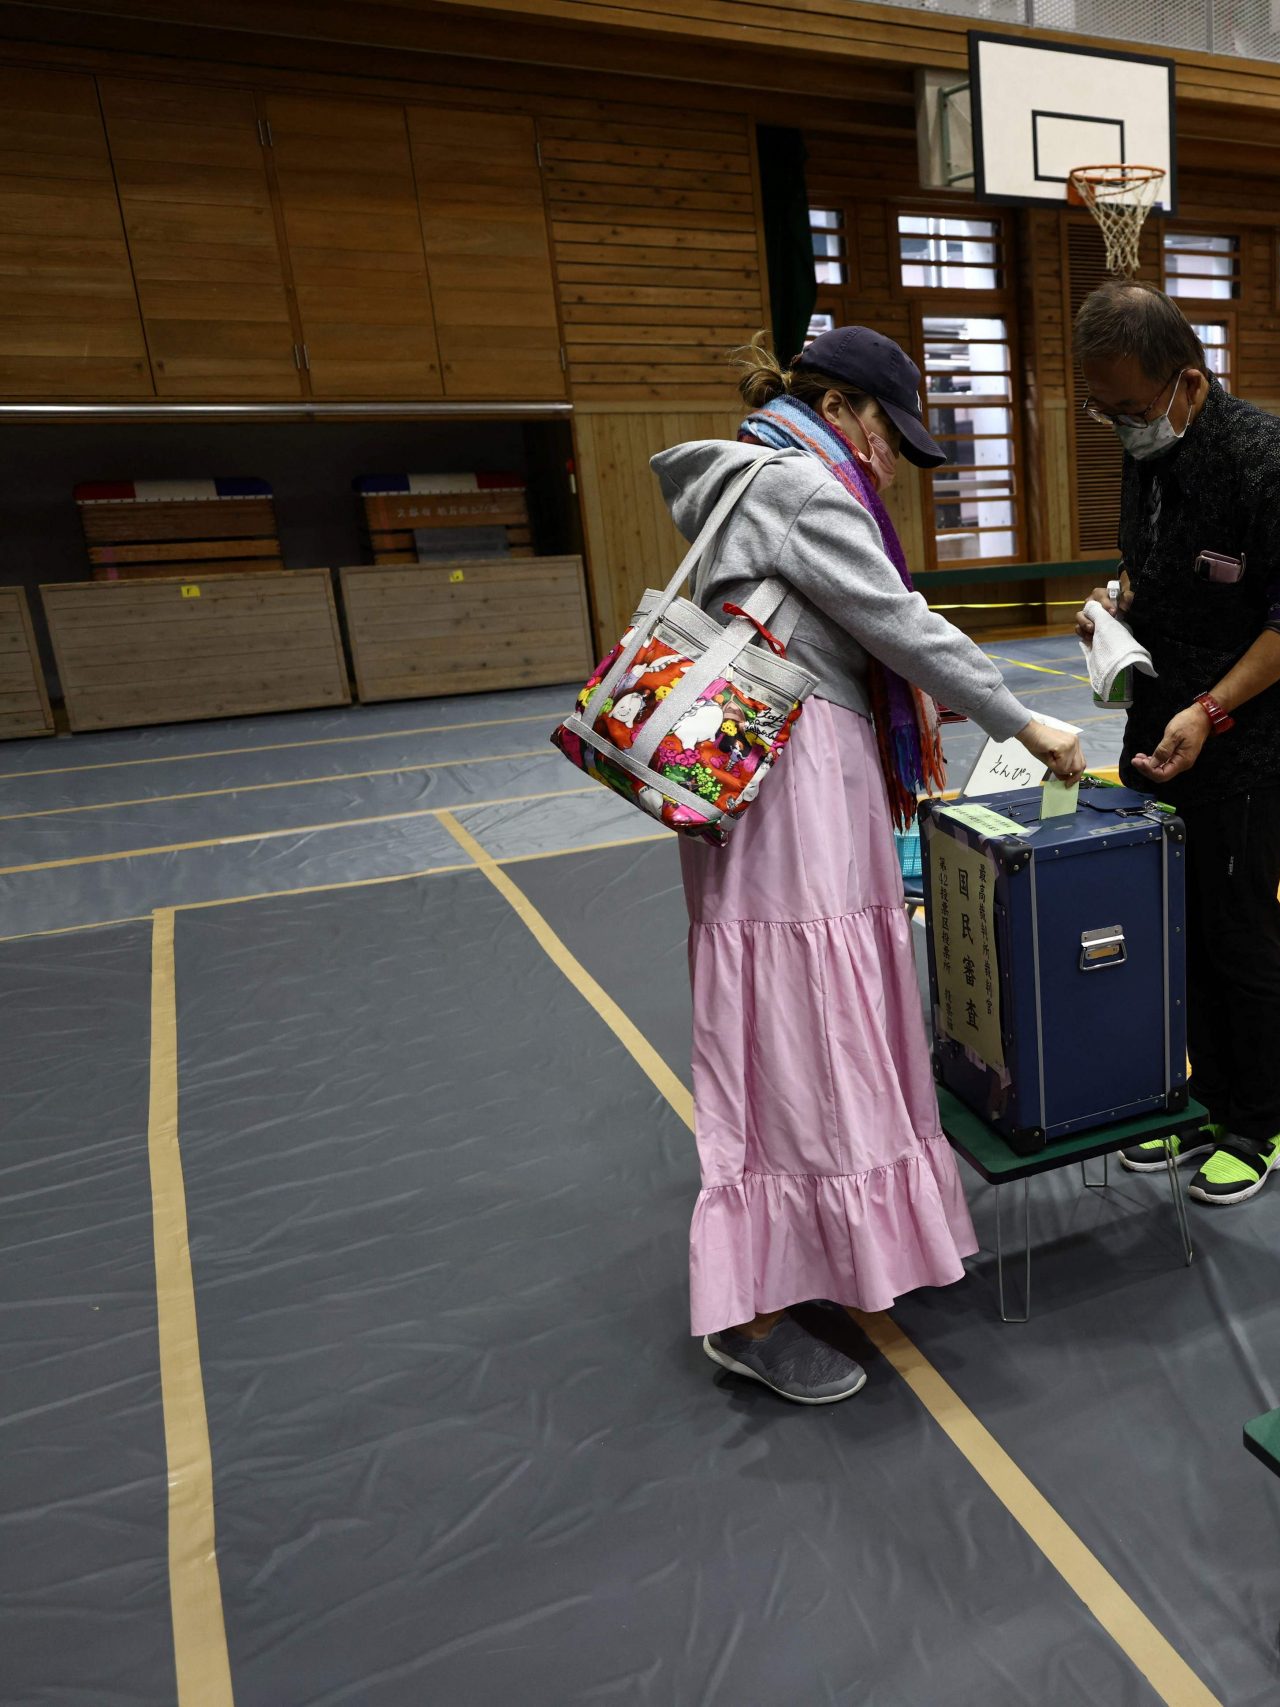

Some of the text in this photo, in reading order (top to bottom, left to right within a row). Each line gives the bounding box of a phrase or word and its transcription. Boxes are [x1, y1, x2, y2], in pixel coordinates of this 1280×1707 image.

[989, 754, 1031, 786] えんぴつ
[958, 868, 979, 1031] 国民審査
